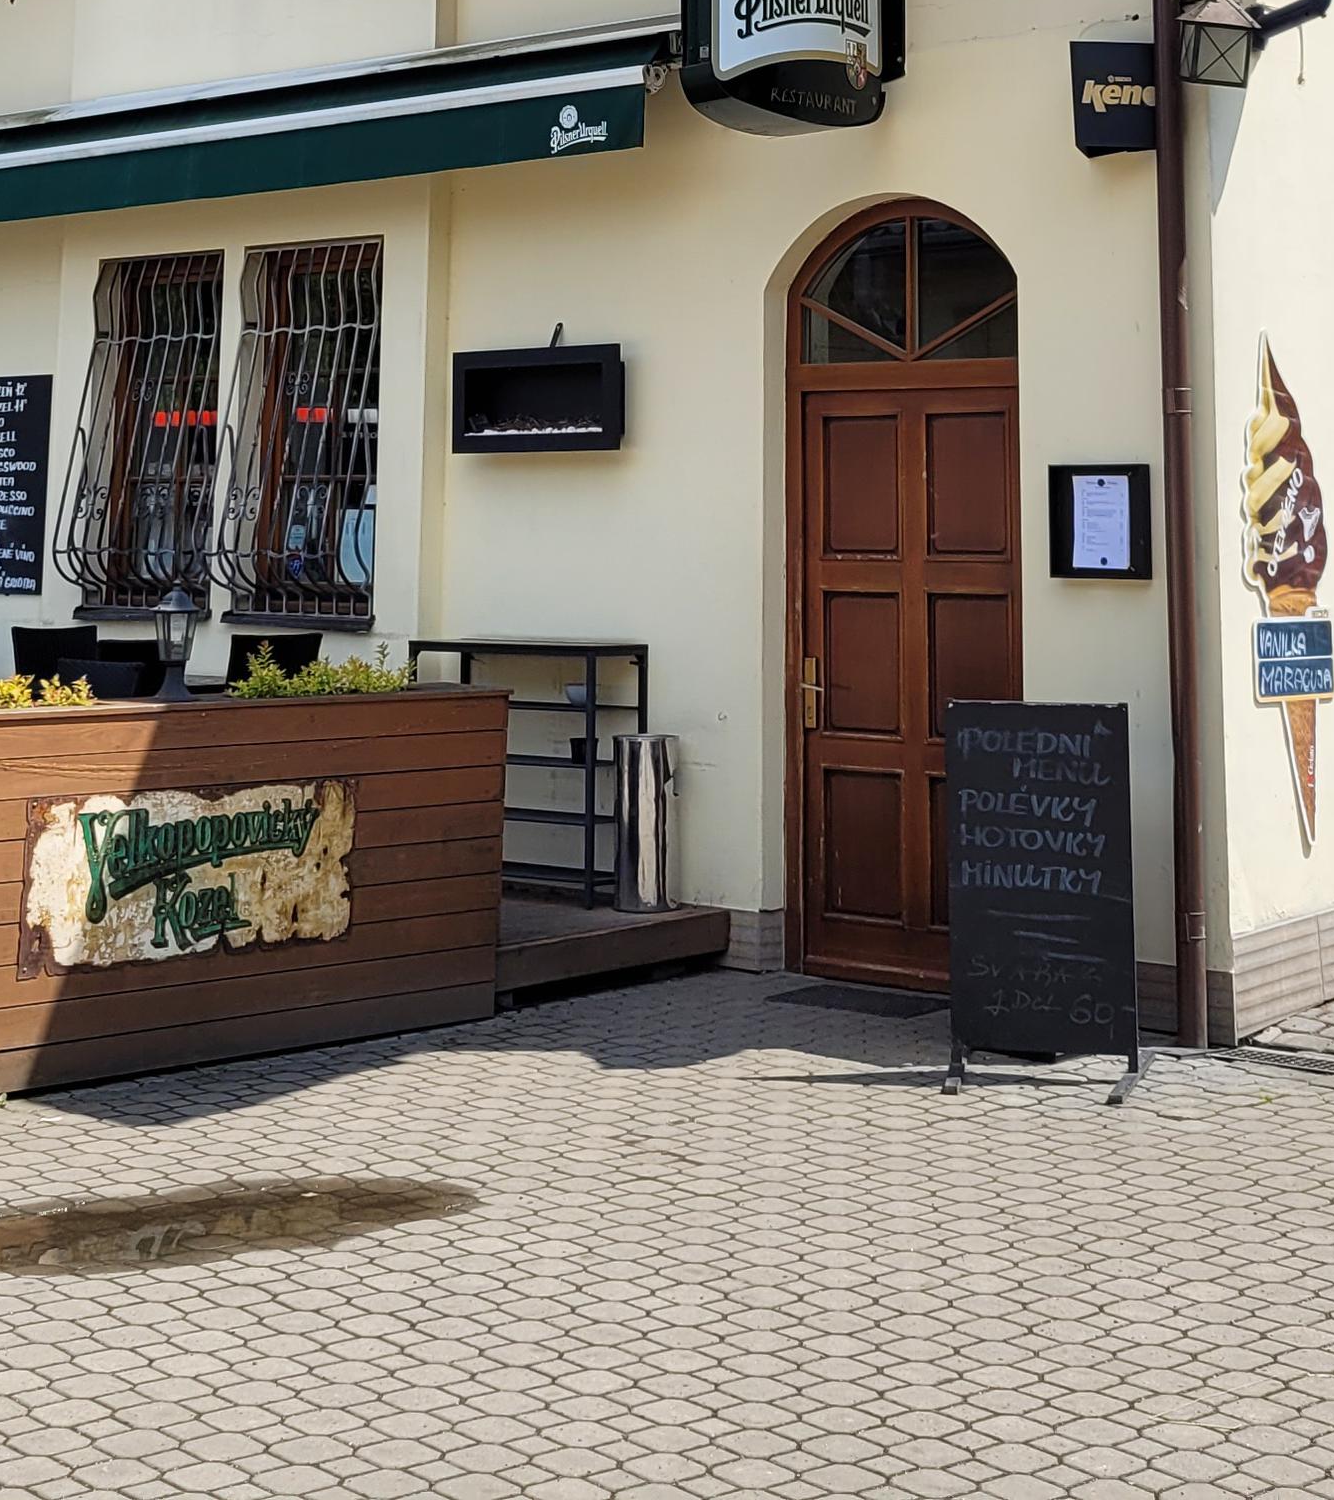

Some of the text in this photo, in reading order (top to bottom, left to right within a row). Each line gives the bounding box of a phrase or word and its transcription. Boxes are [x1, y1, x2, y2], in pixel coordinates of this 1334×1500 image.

[771, 87, 857, 116] RESTAURANT
[550, 120, 609, 155] Pilsner Urquell
[1259, 628, 1307, 660] VANILKA
[960, 823, 1106, 858] HOTOVKY
[150, 871, 243, 950] Kozel
